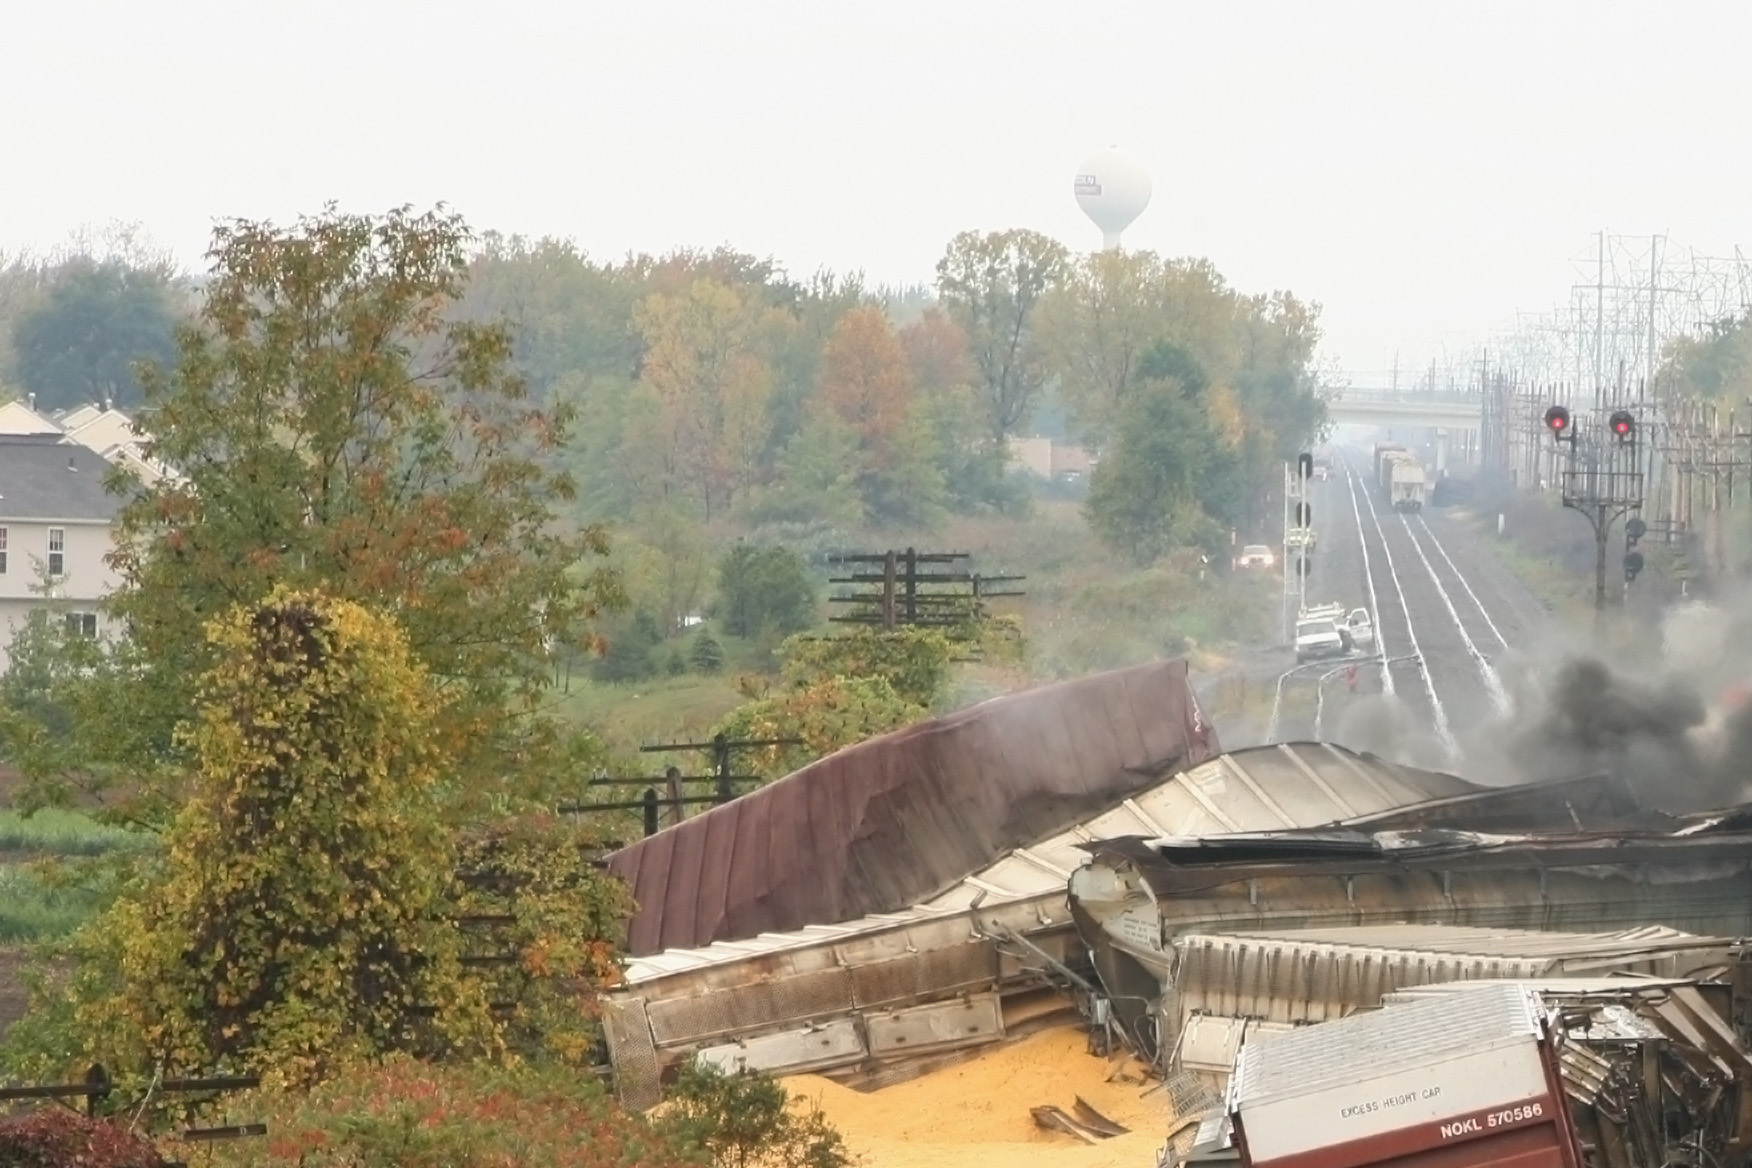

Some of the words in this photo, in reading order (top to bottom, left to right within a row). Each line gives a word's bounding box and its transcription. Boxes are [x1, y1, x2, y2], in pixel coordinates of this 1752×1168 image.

[1340, 1101, 1379, 1119] EXCESS
[1383, 1092, 1417, 1109] HEIGHT
[1422, 1086, 1442, 1100] CAR
[1440, 1117, 1482, 1139] NOKL
[1487, 1102, 1544, 1128] 570586
